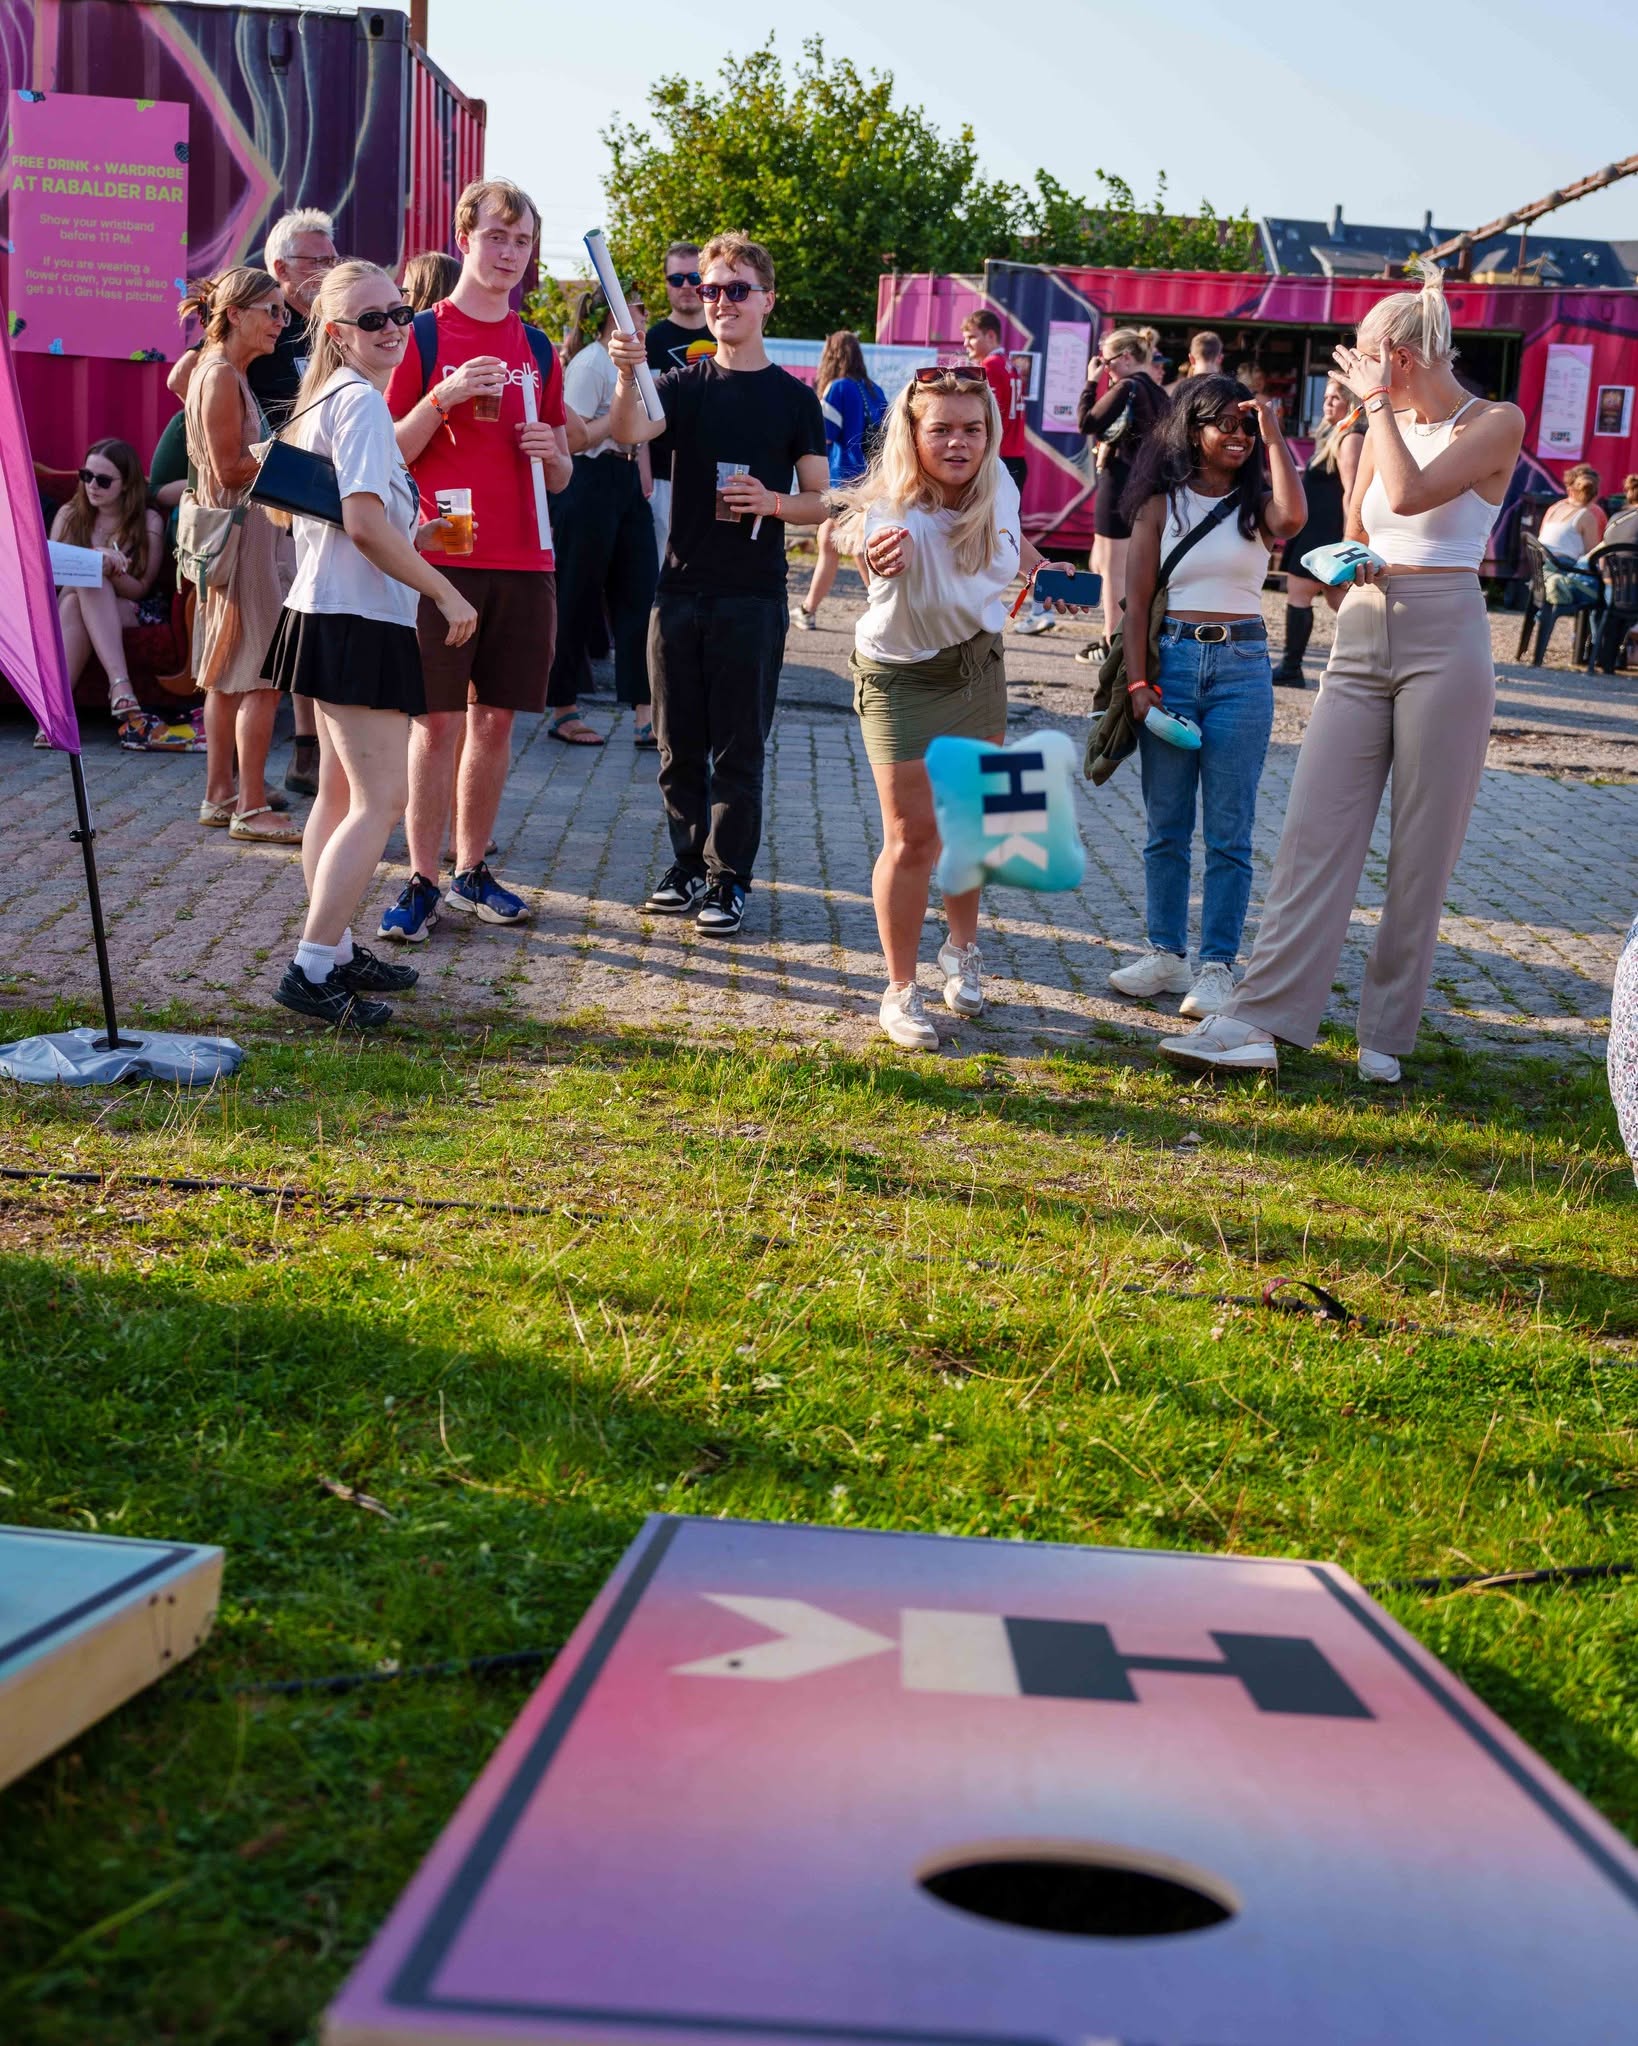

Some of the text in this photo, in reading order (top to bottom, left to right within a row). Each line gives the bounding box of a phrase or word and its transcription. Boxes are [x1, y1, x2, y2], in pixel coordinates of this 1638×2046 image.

[12, 155, 44, 169] FREE
[47, 158, 89, 172] DRINK
[105, 162, 184, 180] WARDROBE
[12, 175, 183, 203] AT RABALDER BAR
[39, 213, 154, 233] Show your wristband
[60, 230, 96, 241] before
[100, 231, 109, 242] 11
[43, 255, 150, 275] If you are wearing a
[25, 269, 59, 281] flower
[102, 277, 122, 288] you
[125, 276, 143, 287] will
[145, 278, 168, 289] also
[26, 284, 44, 296] get
[75, 286, 93, 298] Gin
[95, 288, 122, 300] Hass
